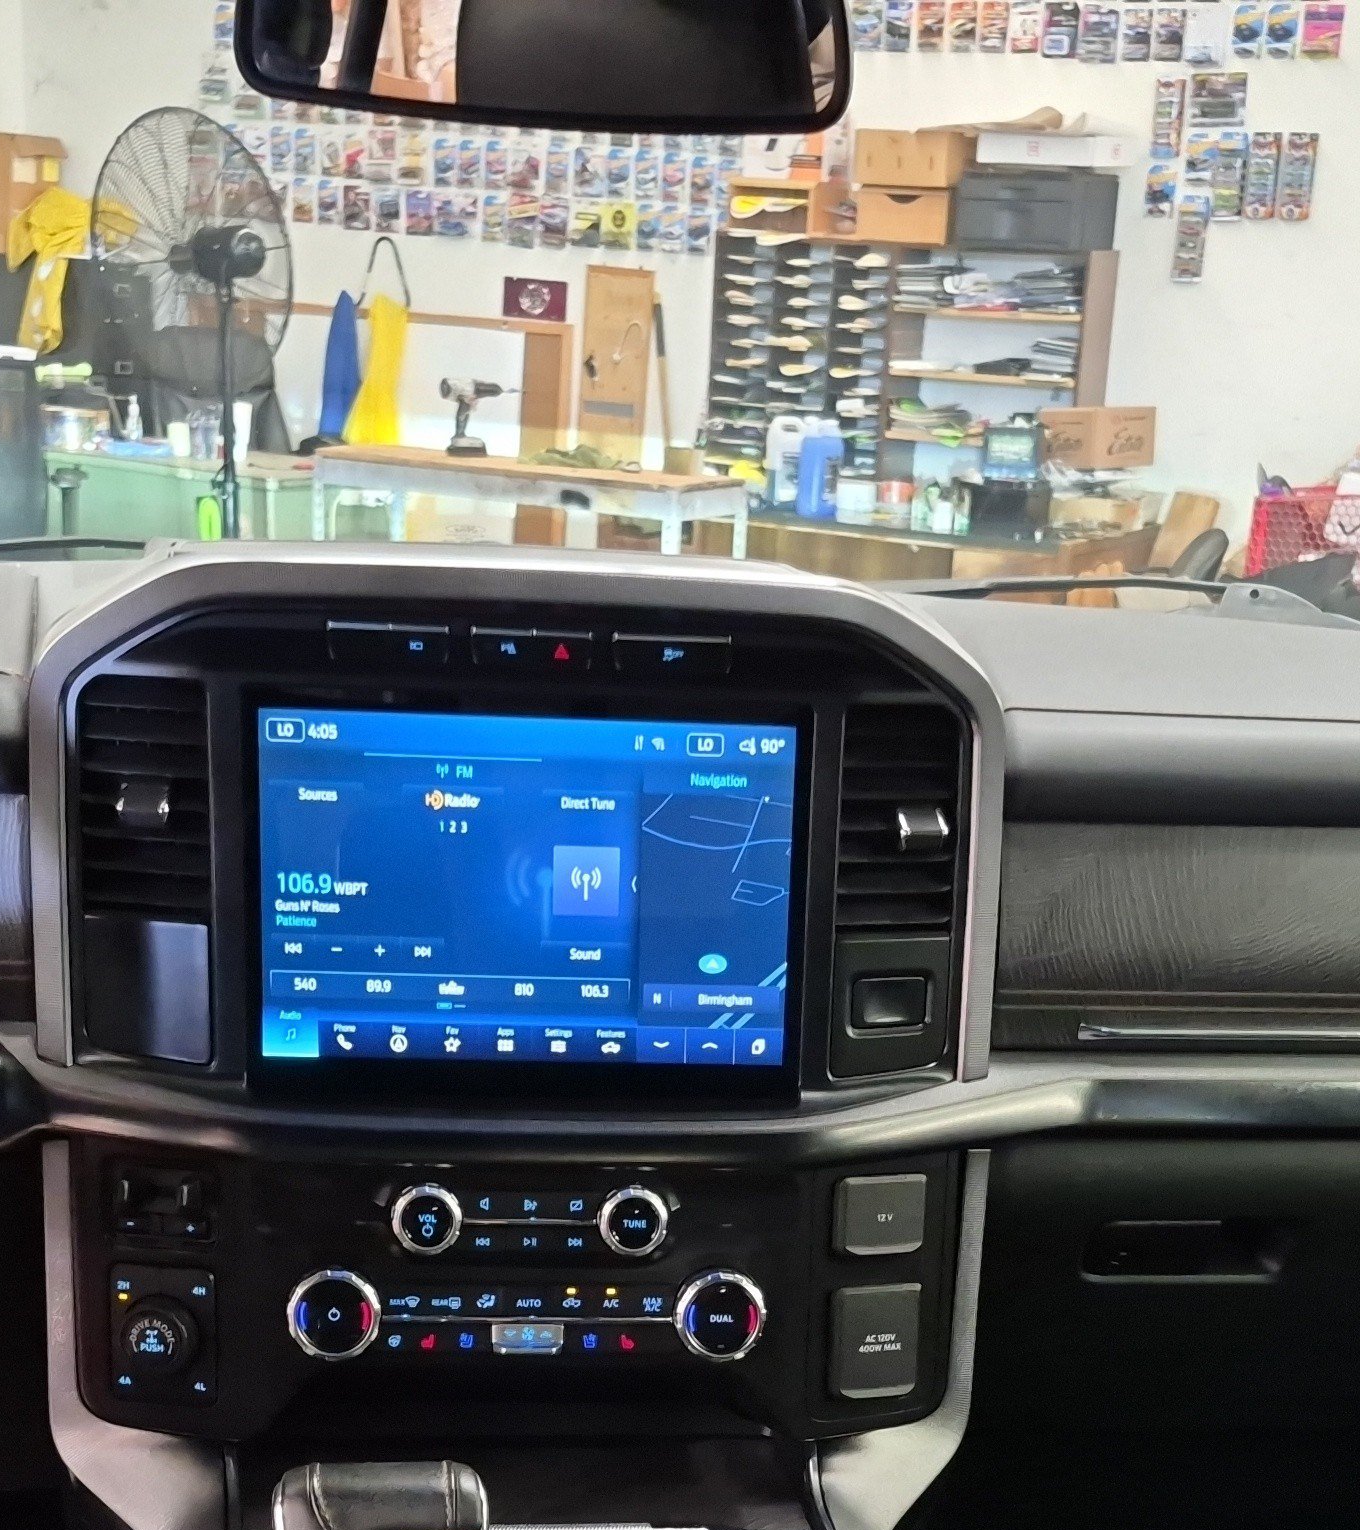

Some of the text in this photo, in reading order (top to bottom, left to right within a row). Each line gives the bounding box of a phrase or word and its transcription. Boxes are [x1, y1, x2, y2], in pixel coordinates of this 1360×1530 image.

[276, 722, 339, 740] LO 4:05
[697, 737, 715, 752] LO
[456, 765, 473, 779] FM
[690, 772, 748, 789] Navigation
[297, 786, 339, 802] Sources
[560, 796, 616, 811] Direct Tune
[276, 871, 332, 894] 106.9
[274, 898, 300, 912] Guns
[311, 900, 341, 914] Roses
[276, 914, 317, 927] Patience
[569, 947, 602, 961] Sound
[293, 976, 317, 992] 540
[513, 982, 535, 997] 810
[580, 984, 609, 998] 106.3
[697, 992, 753, 1008] Birmingham
[279, 1009, 302, 1021] Audio
[333, 1022, 357, 1033] Phone
[544, 1027, 573, 1038] Settings
[417, 1213, 438, 1224] VOL
[622, 1218, 647, 1229] TUNE
[516, 1298, 542, 1308] AUTO
[602, 1298, 619, 1309] A/C
[642, 1297, 663, 1306] MAX
[709, 1314, 734, 1323] DUAL
[129, 1319, 176, 1343] DRIVE MODE
[140, 1342, 165, 1353] PUSH
[883, 1342, 902, 1351] MAX
